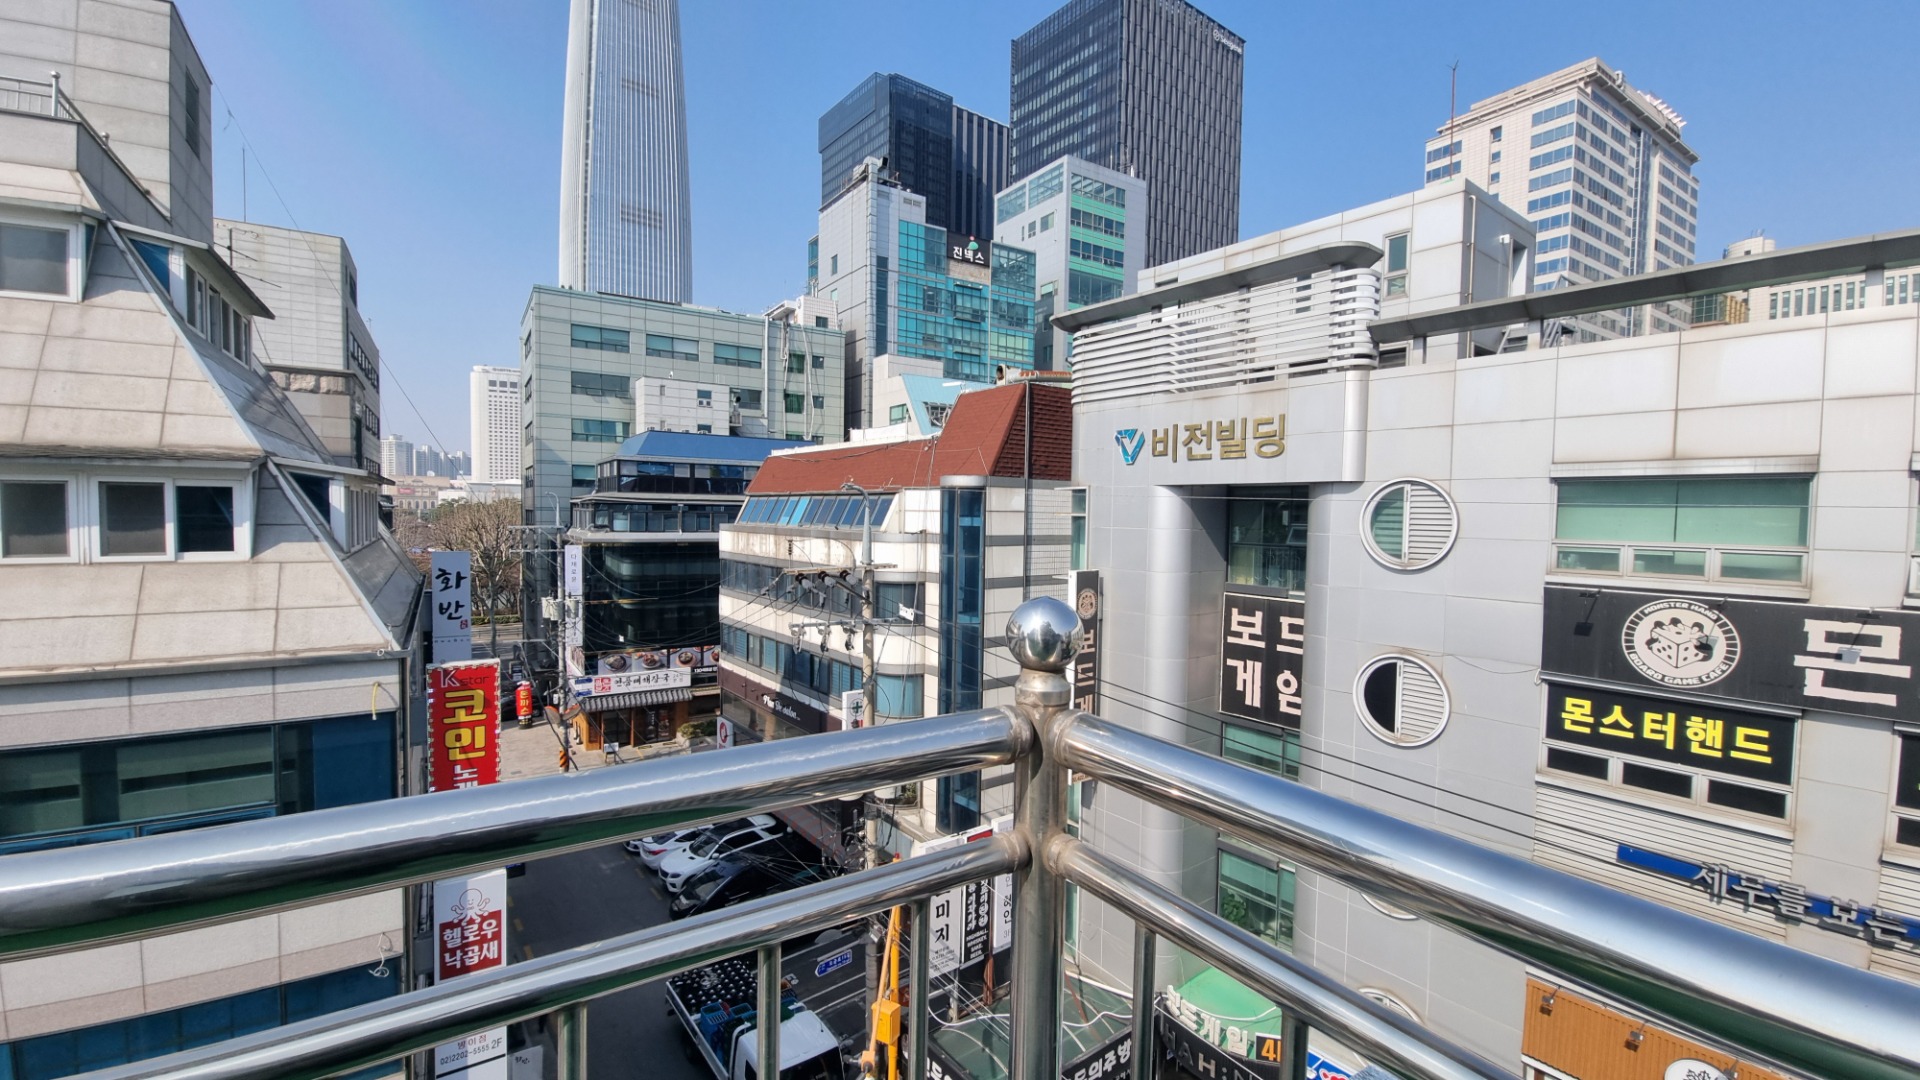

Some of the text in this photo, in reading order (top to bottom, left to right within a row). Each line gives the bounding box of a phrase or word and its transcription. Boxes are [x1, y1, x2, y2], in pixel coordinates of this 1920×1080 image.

[1151, 413, 1286, 463] 비전빌딩
[435, 567, 468, 620] 화반
[1643, 601, 1718, 620] MONSTER HAND
[1226, 607, 1305, 655] 보드
[1628, 652, 1729, 686] BOARD GAME CAFE
[1794, 618, 1912, 707] 몬
[443, 689, 487, 761] 코인
[1561, 696, 1773, 764] 몬스터핸드
[442, 918, 499, 949] 헬로우
[443, 940, 499, 969] 낙곱새
[491, 1037, 503, 1050] 2F
[1166, 984, 1249, 1057] 보드게임
